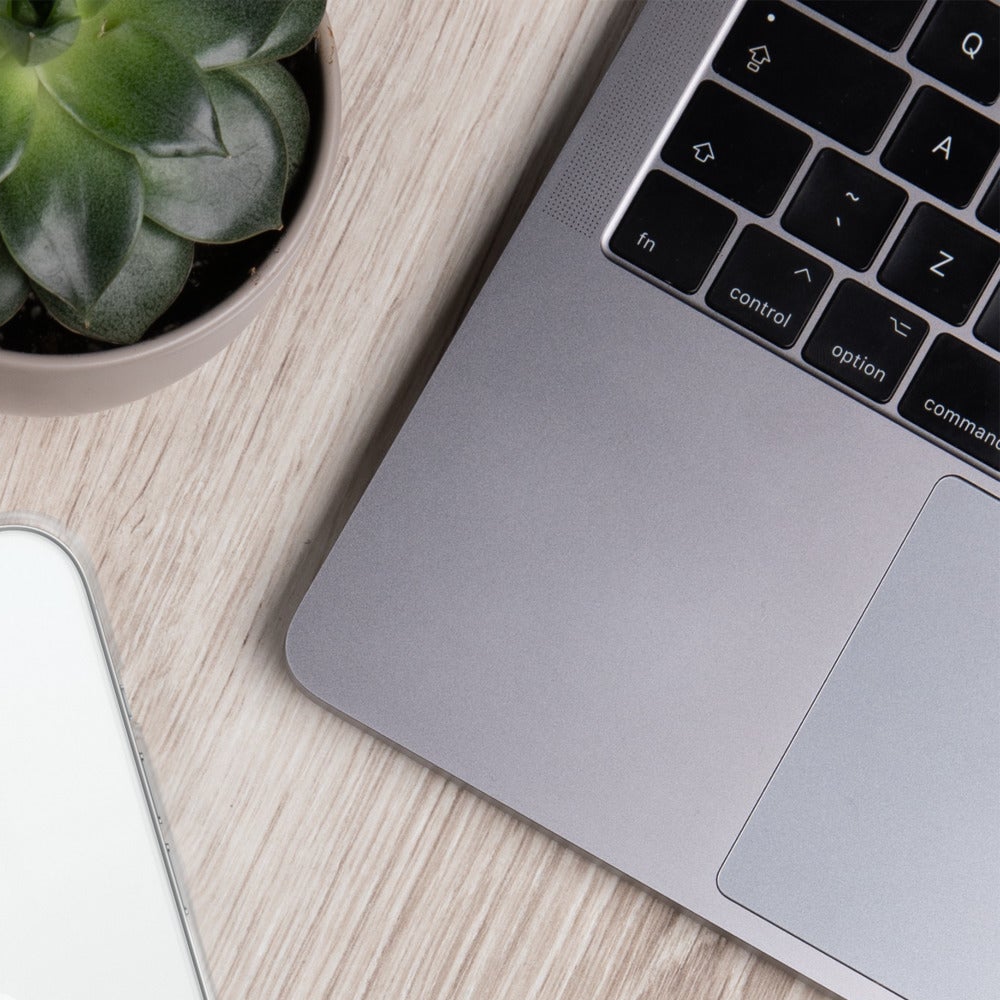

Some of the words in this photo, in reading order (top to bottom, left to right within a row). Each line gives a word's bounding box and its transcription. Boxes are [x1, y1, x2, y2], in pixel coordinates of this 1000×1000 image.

[962, 32, 983, 60] Q
[932, 135, 952, 160] A
[636, 231, 656, 252] fn
[929, 250, 954, 277] Z
[729, 286, 792, 328] control
[831, 343, 887, 383] option
